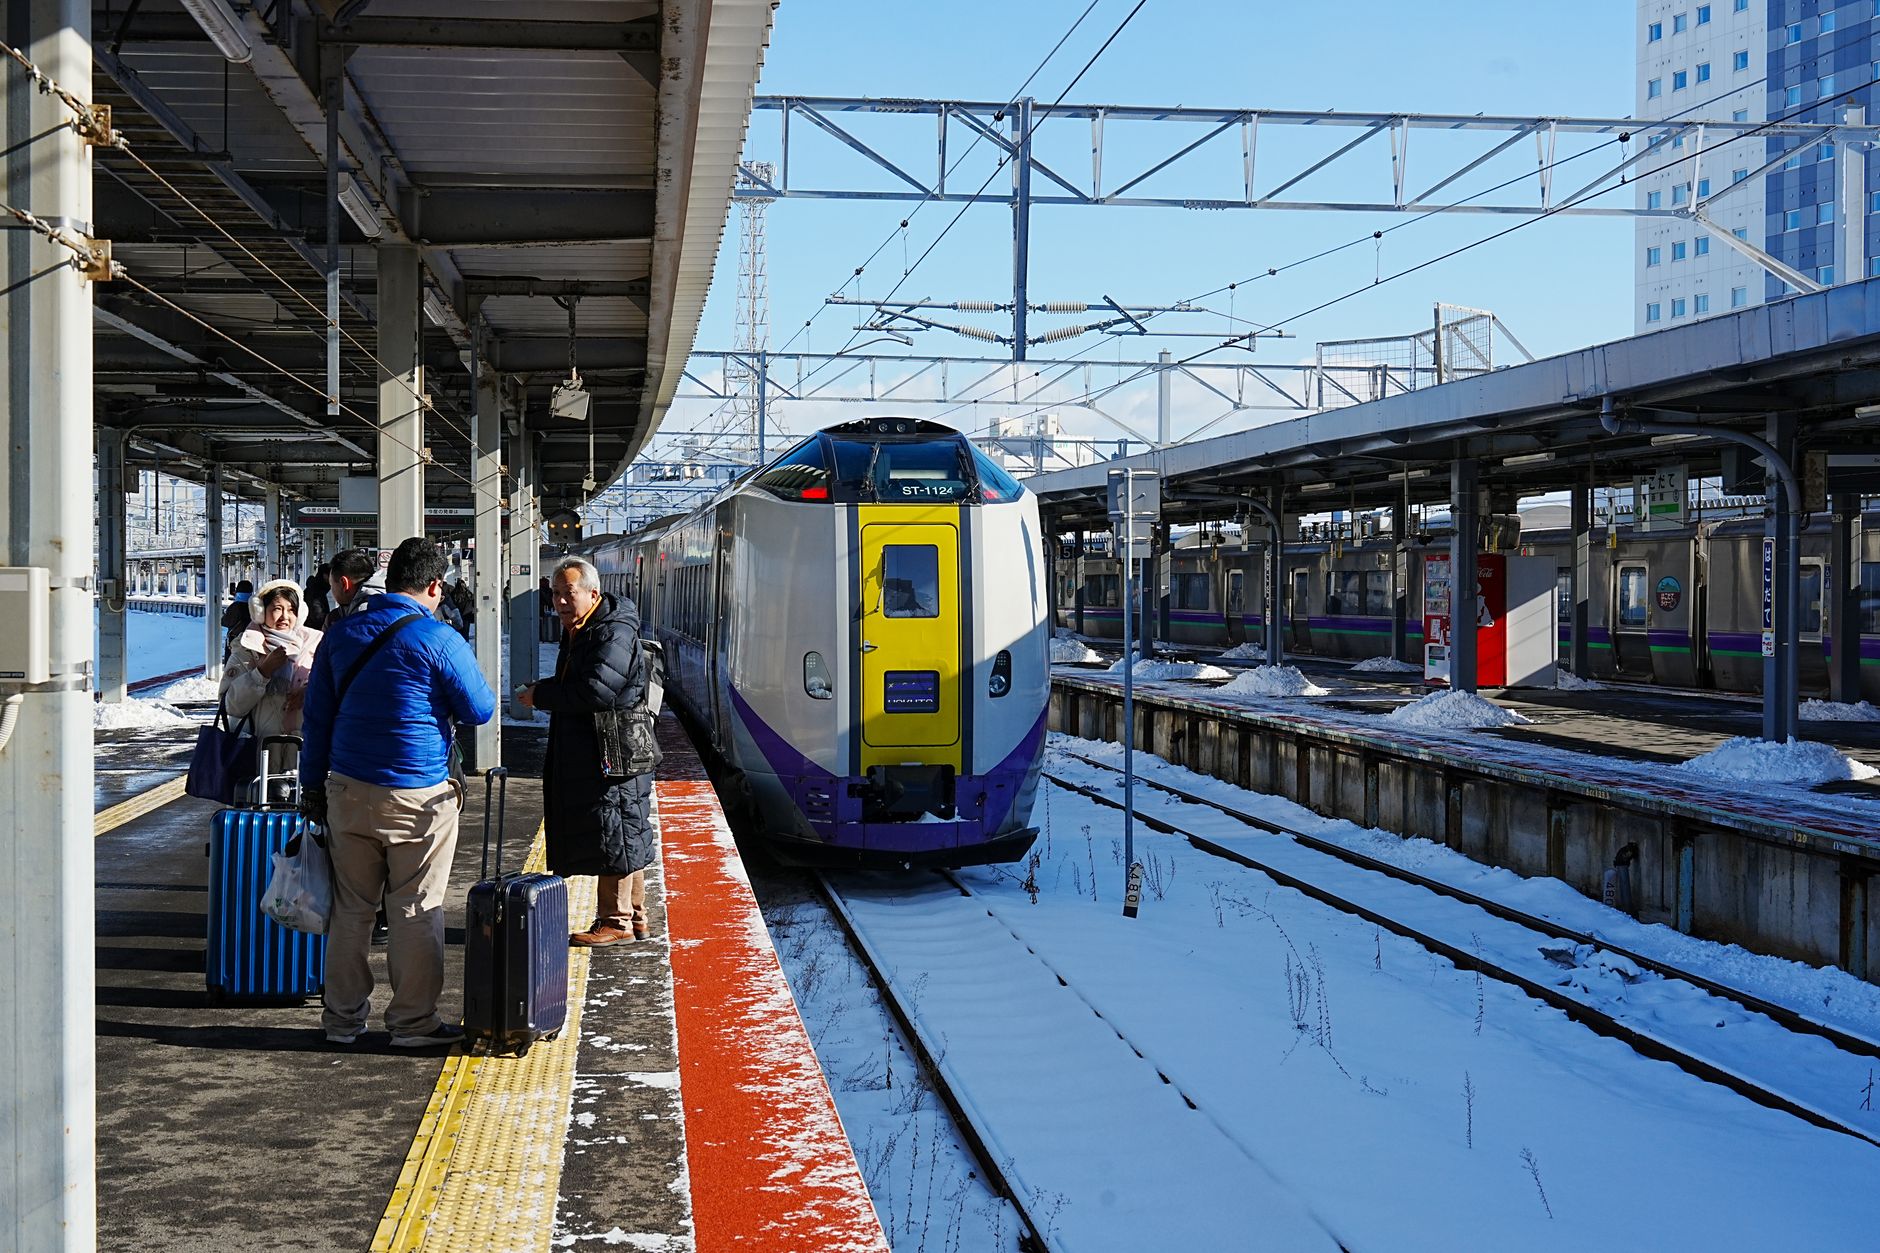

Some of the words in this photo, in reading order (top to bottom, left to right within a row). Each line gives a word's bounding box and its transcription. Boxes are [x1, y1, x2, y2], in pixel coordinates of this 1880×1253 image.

[902, 486, 954, 495] ST-1124
[464, 549, 471, 559] 7
[1063, 547, 1071, 558] 5
[1764, 547, 1772, 623] はこだて
[1127, 873, 1139, 902] 480
